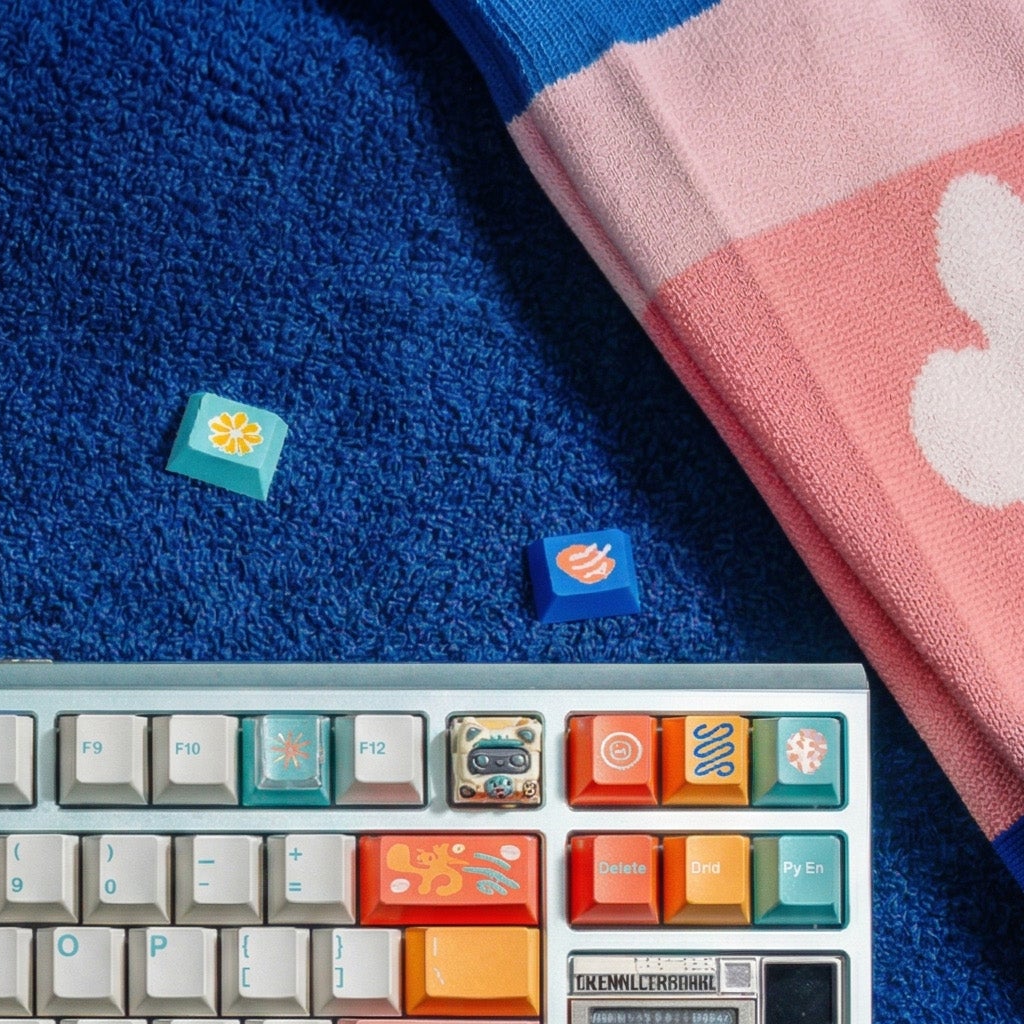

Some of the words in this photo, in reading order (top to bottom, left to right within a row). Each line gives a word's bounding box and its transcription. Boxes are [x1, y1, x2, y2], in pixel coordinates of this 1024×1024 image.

[82, 742, 102, 753] F9
[176, 743, 199, 754] F10
[360, 743, 384, 754] F12
[13, 843, 20, 860] (
[107, 844, 114, 861] )
[289, 849, 301, 860] +
[598, 861, 647, 875] Delete
[783, 861, 802, 878] Py
[805, 861, 824, 875] En
[12, 878, 24, 892] 9
[104, 879, 116, 894] 0
[289, 881, 301, 892] =
[57, 934, 79, 957] O
[150, 934, 168, 957] P
[242, 936, 249, 958] {
[337, 936, 343, 960] }
[242, 967, 249, 988] [
[336, 967, 344, 988] ]
